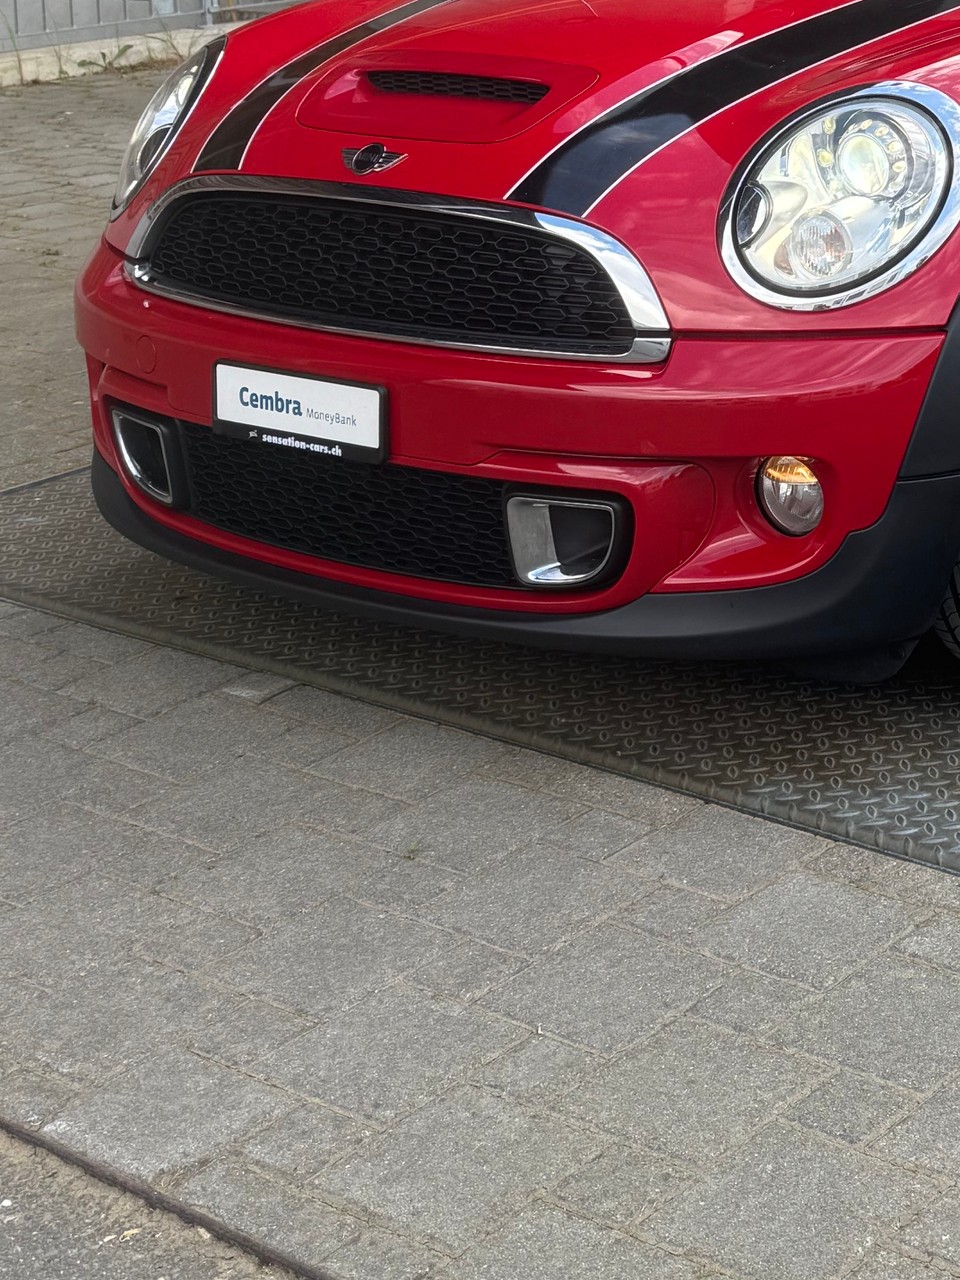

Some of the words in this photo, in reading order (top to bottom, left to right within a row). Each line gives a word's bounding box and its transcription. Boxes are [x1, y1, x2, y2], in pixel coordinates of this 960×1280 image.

[239, 386, 303, 417] Cembra
[306, 407, 357, 427] MoneyBank
[262, 432, 342, 457] sensation-cars.ch
